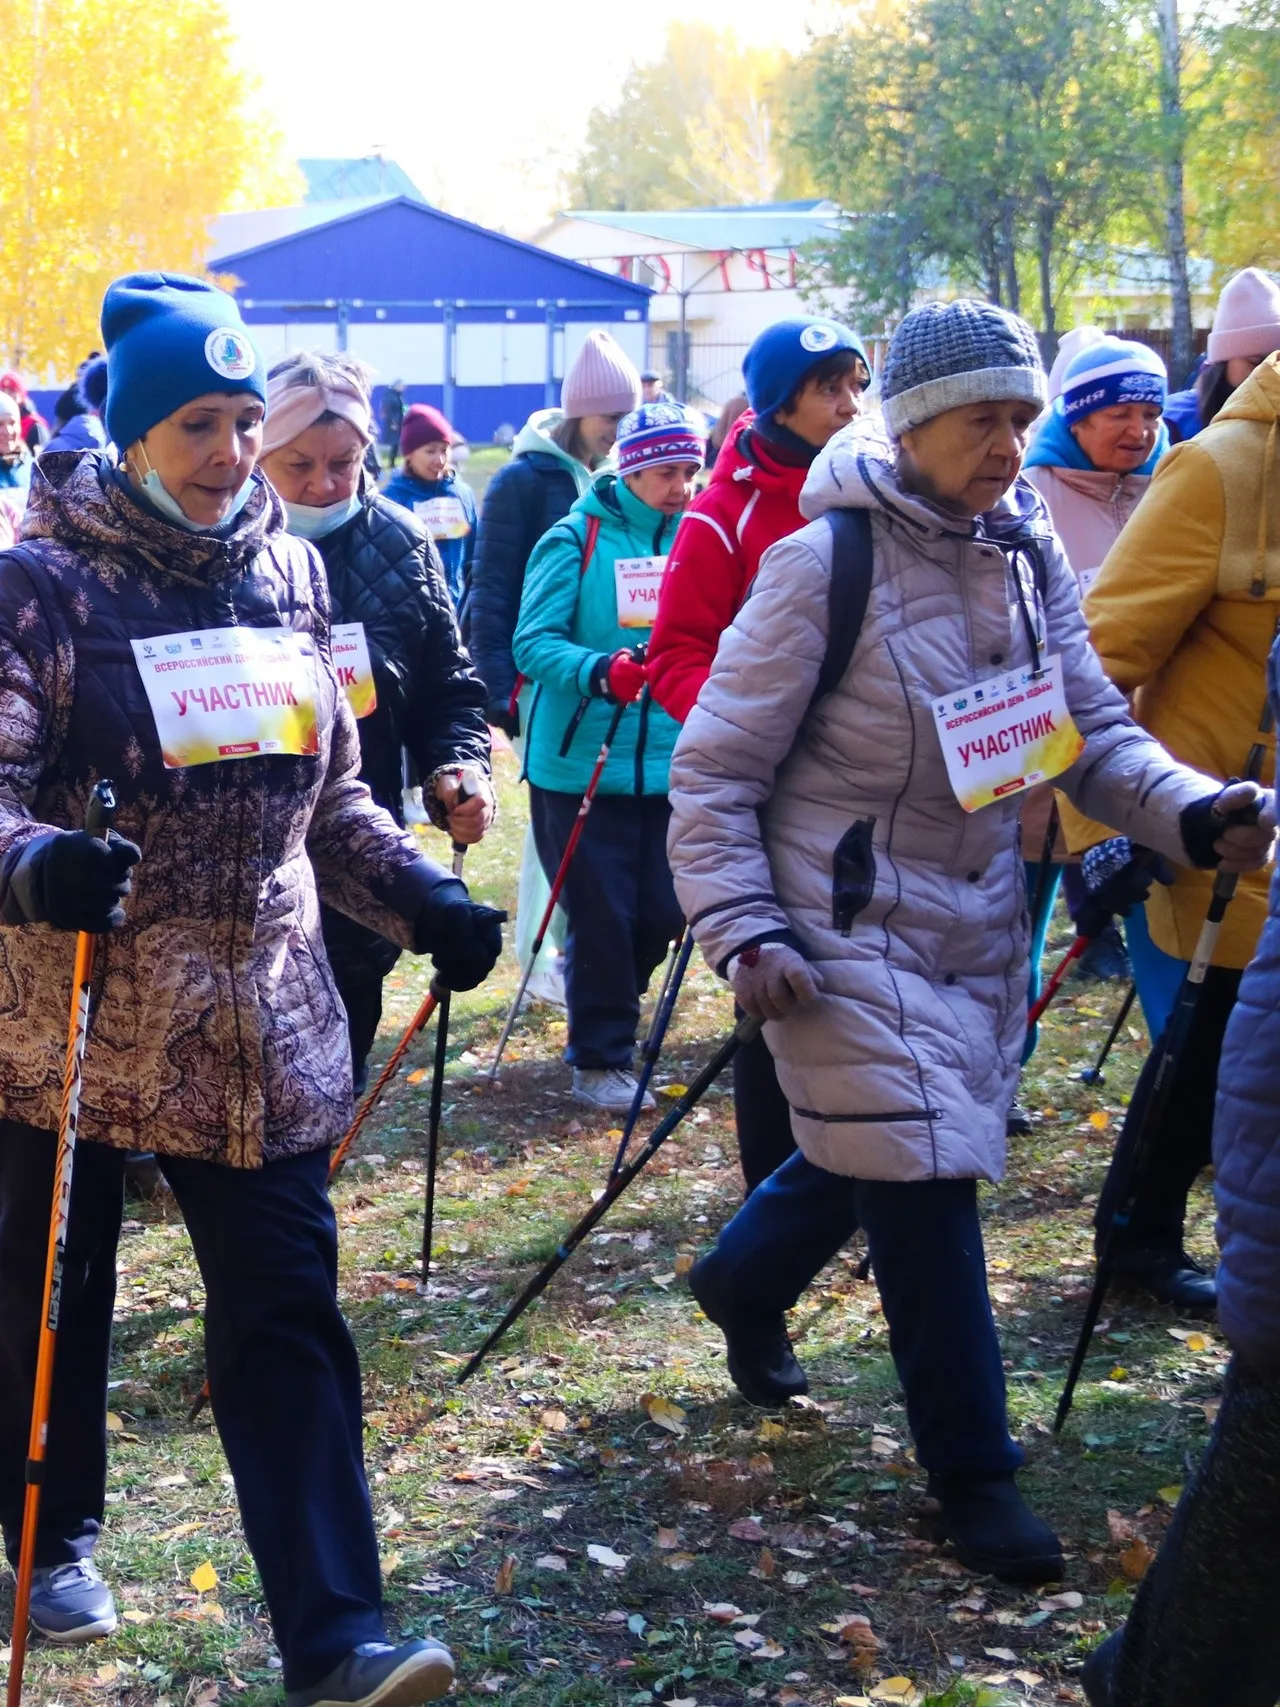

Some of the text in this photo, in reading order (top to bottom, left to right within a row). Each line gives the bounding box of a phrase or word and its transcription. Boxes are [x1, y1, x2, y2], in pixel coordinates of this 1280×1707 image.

[154, 652, 233, 673] ВСЕРОССИЙСКИЙ
[170, 681, 298, 717] УЧАСТНИК
[945, 681, 1053, 731] ВСЕРОССИЙСКИЙ ДЕНЬ ХОДЬБЫ
[957, 709, 1057, 768] УЧАСТНИК
[47, 1244, 65, 1331] Larsen
